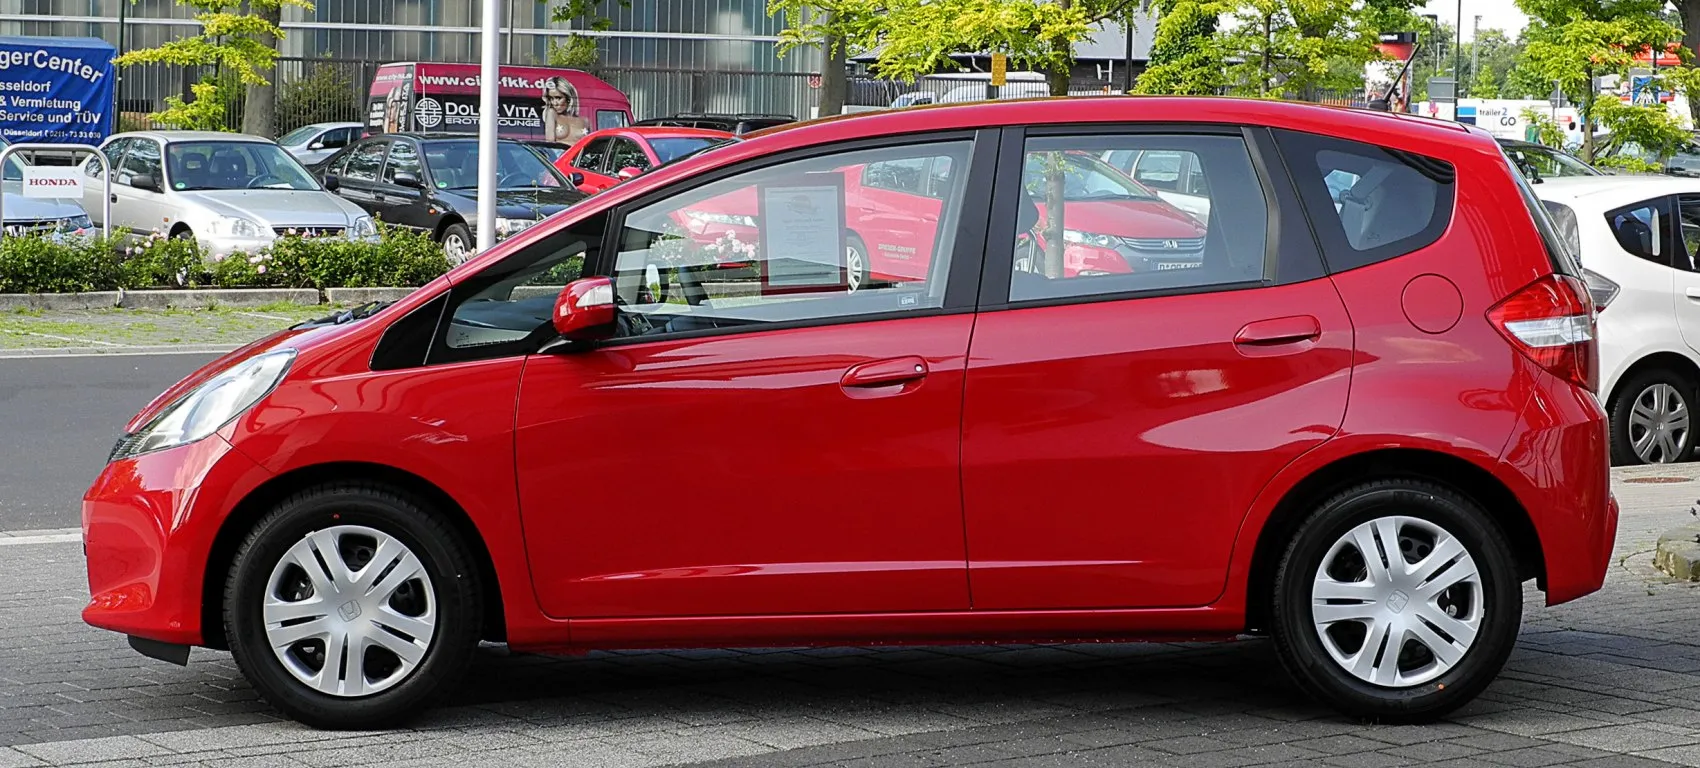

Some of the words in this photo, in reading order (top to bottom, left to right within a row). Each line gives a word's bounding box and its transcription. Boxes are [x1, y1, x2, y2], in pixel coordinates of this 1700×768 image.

[0, 50, 104, 83] gerCenter
[419, 76, 555, 89] www.ci-fkk.de
[11, 96, 81, 112] Vermietung
[0, 110, 44, 122] Service
[48, 113, 71, 123] und
[75, 111, 101, 124] TÜV
[503, 104, 539, 118] VITA
[1500, 116, 1516, 126] GO
[4, 129, 42, 137] Düsseldorf
[29, 178, 77, 186] HONDA
